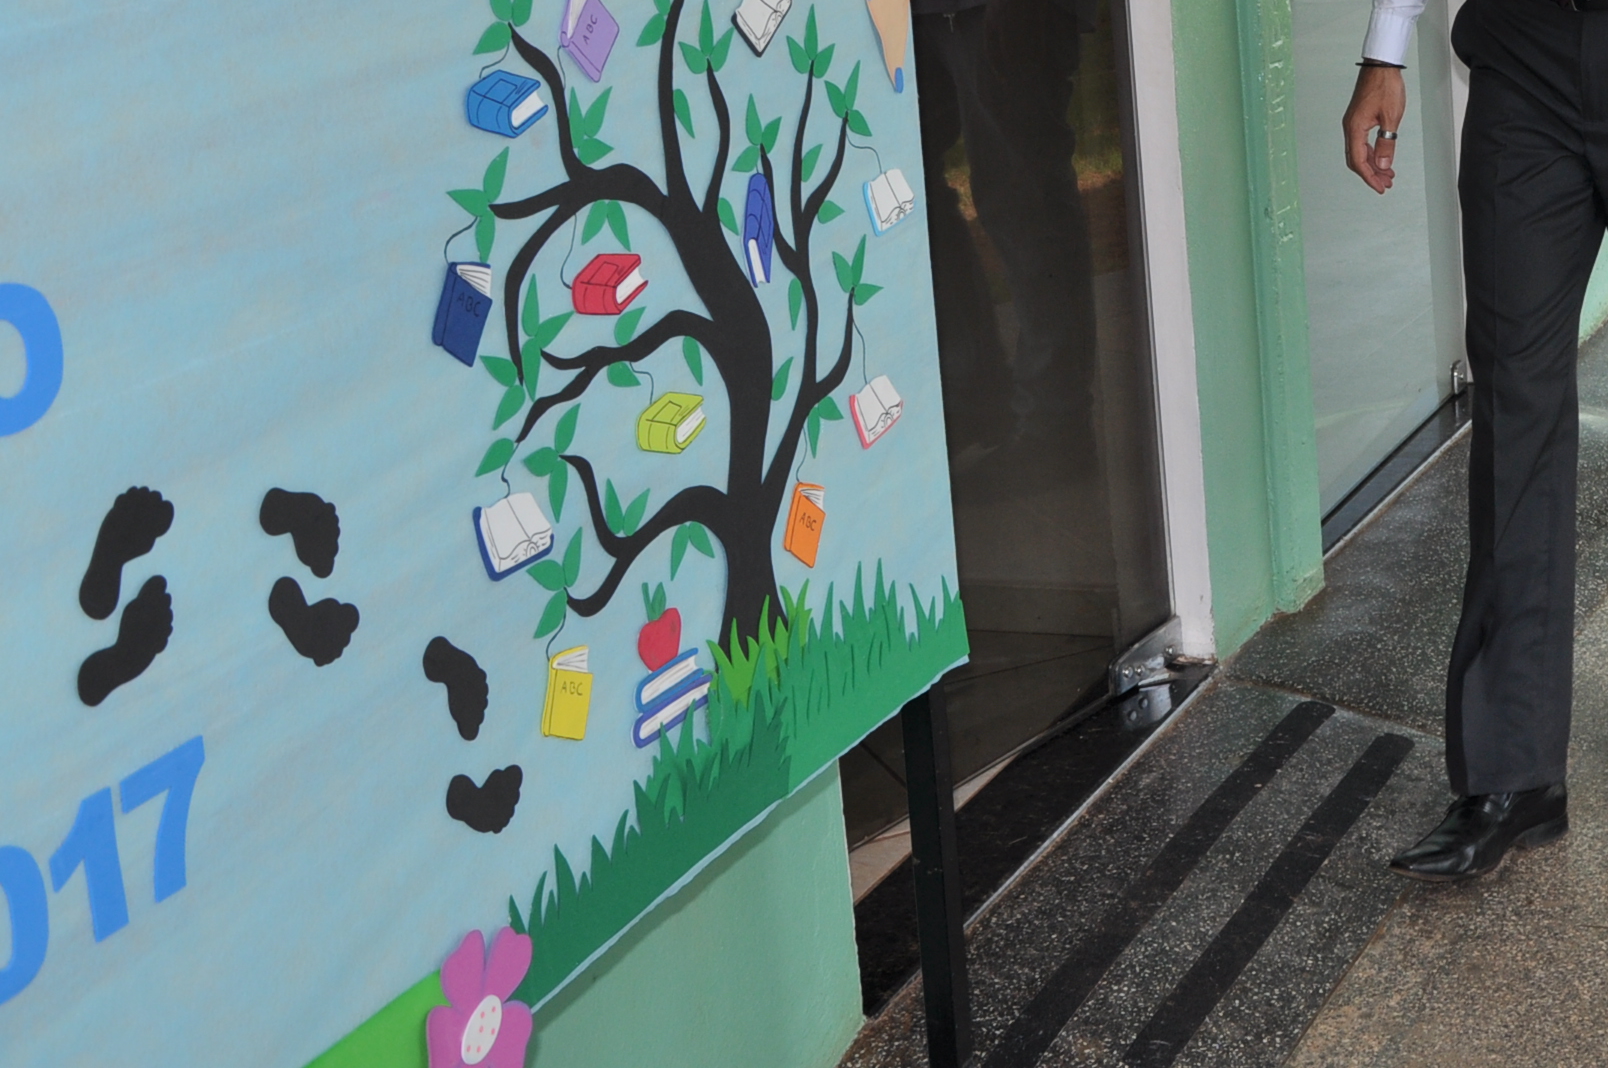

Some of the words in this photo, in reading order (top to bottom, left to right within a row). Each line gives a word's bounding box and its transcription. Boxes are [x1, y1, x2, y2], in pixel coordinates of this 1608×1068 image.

[457, 292, 481, 318] ABC
[799, 512, 817, 532] ABC
[560, 680, 584, 697] ABC
